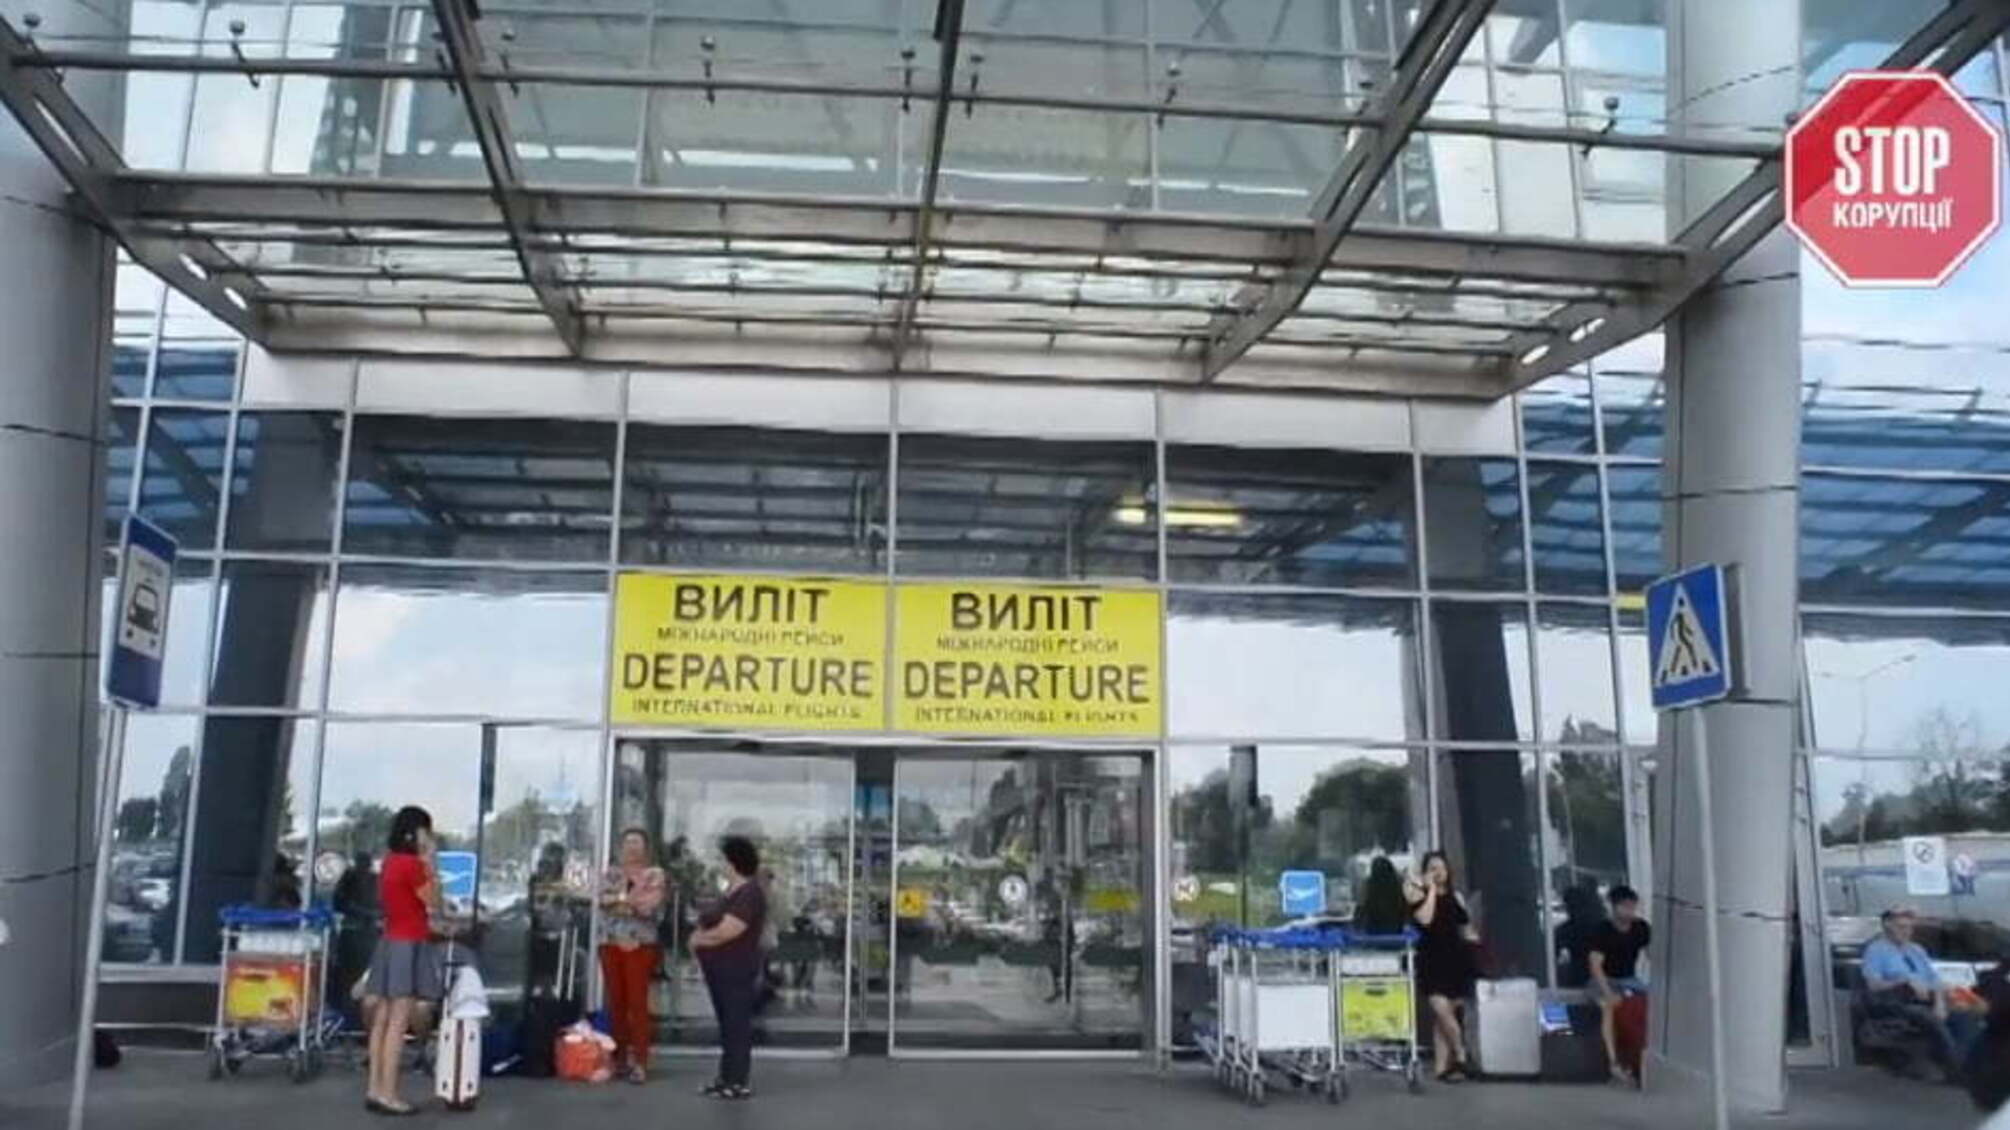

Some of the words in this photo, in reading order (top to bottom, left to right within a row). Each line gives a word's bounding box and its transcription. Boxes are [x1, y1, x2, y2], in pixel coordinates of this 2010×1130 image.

[674, 583, 830, 623] ВИЛІТ
[951, 592, 1102, 631] ВИЛІТ
[622, 652, 874, 698] DEPARTURE
[904, 661, 1151, 704] DEPARTURE
[632, 699, 776, 717] INTERNATIONAL
[915, 706, 1055, 723] INTERNATIONAL
